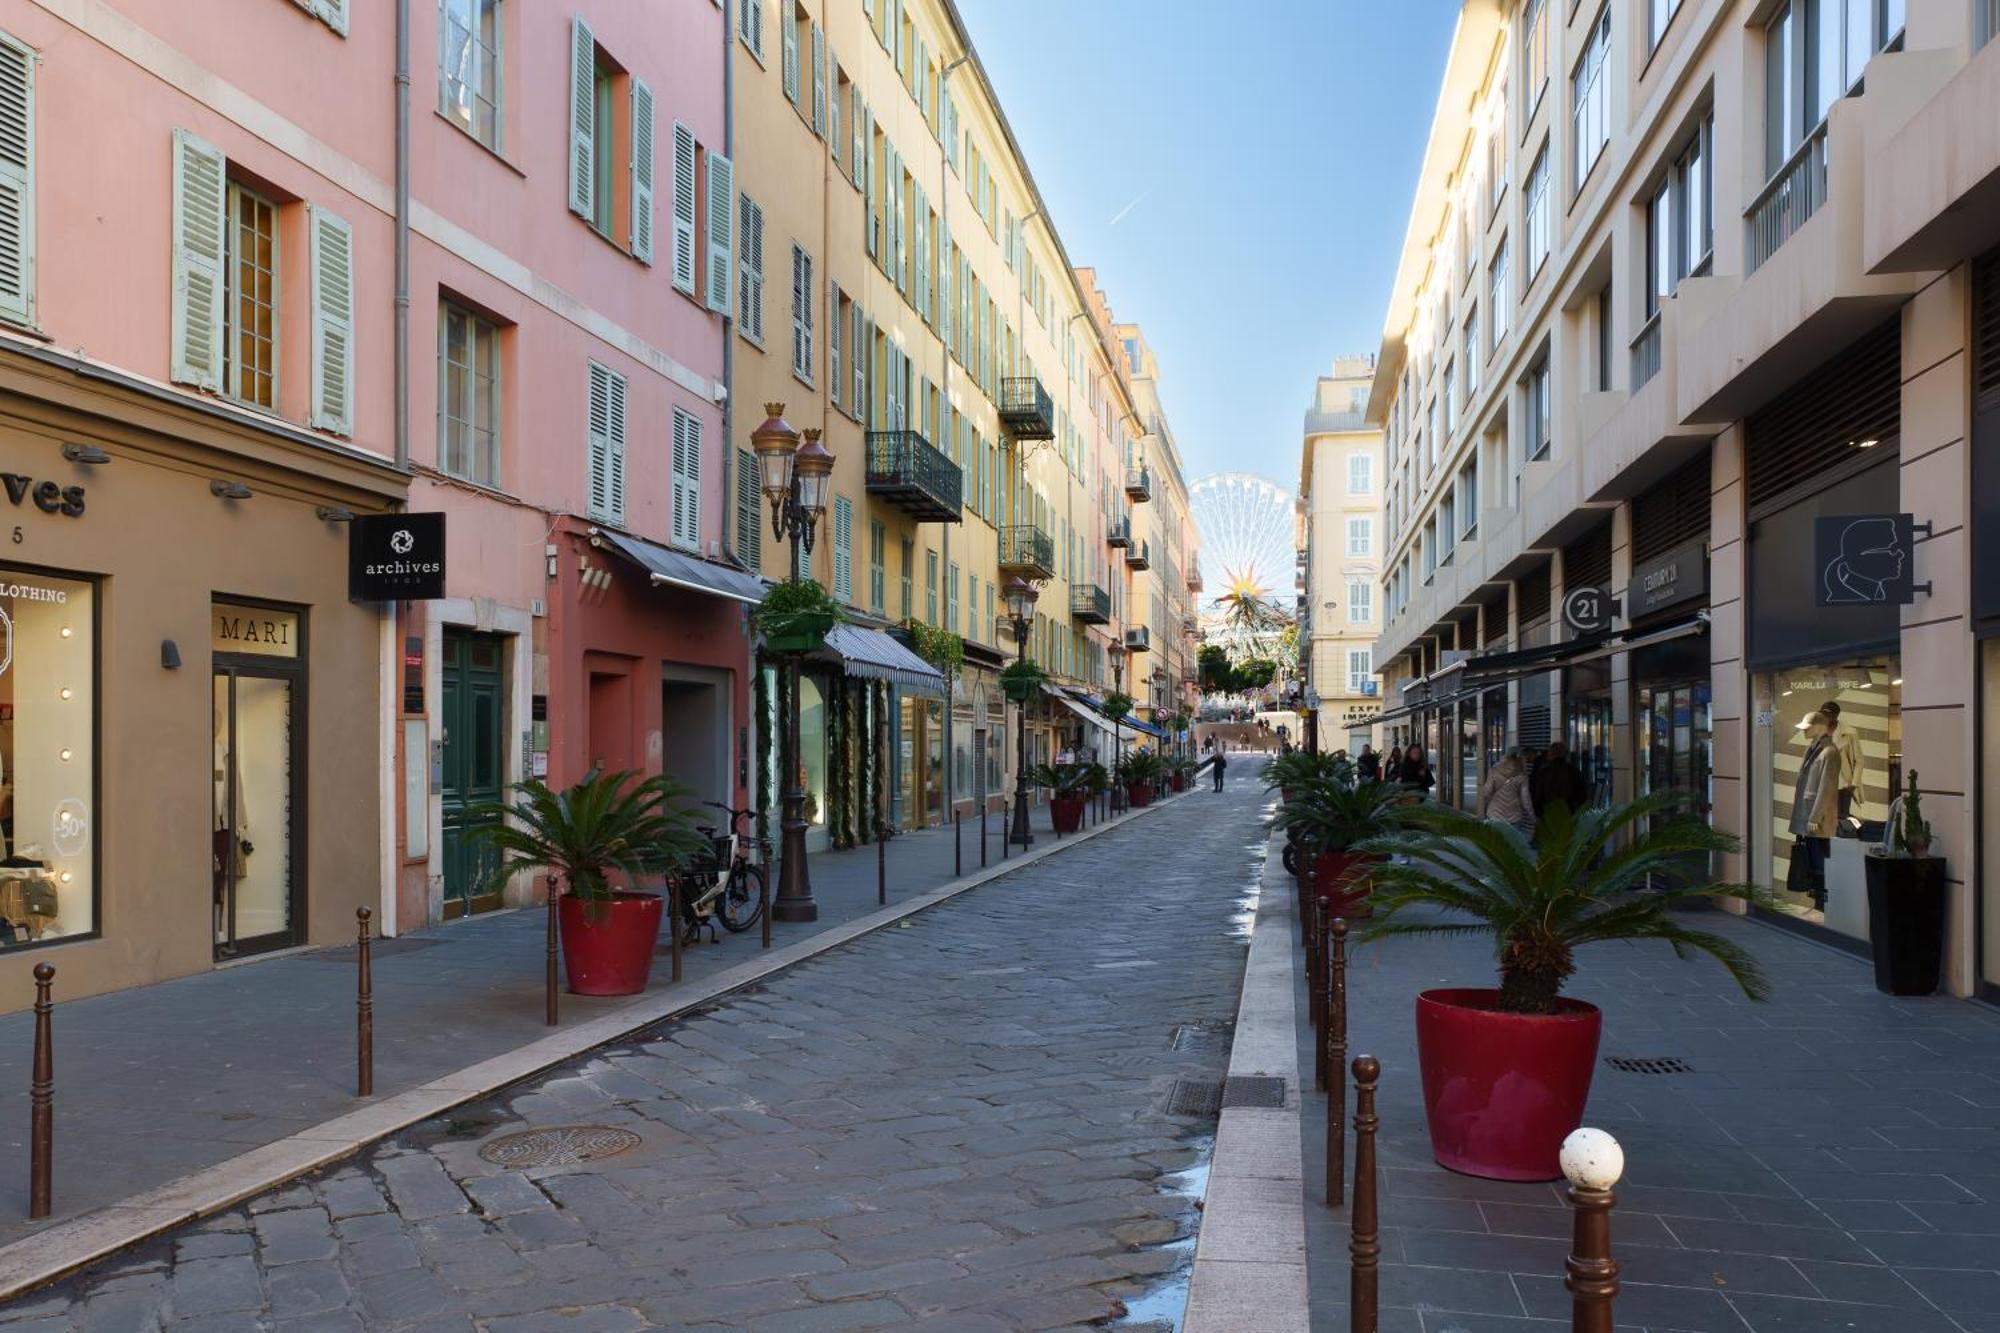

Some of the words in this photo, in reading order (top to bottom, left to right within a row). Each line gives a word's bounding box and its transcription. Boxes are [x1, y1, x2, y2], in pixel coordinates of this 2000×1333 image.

[366, 561, 440, 575] archives
[1577, 598, 1598, 618] 21
[220, 616, 289, 645] MARI
